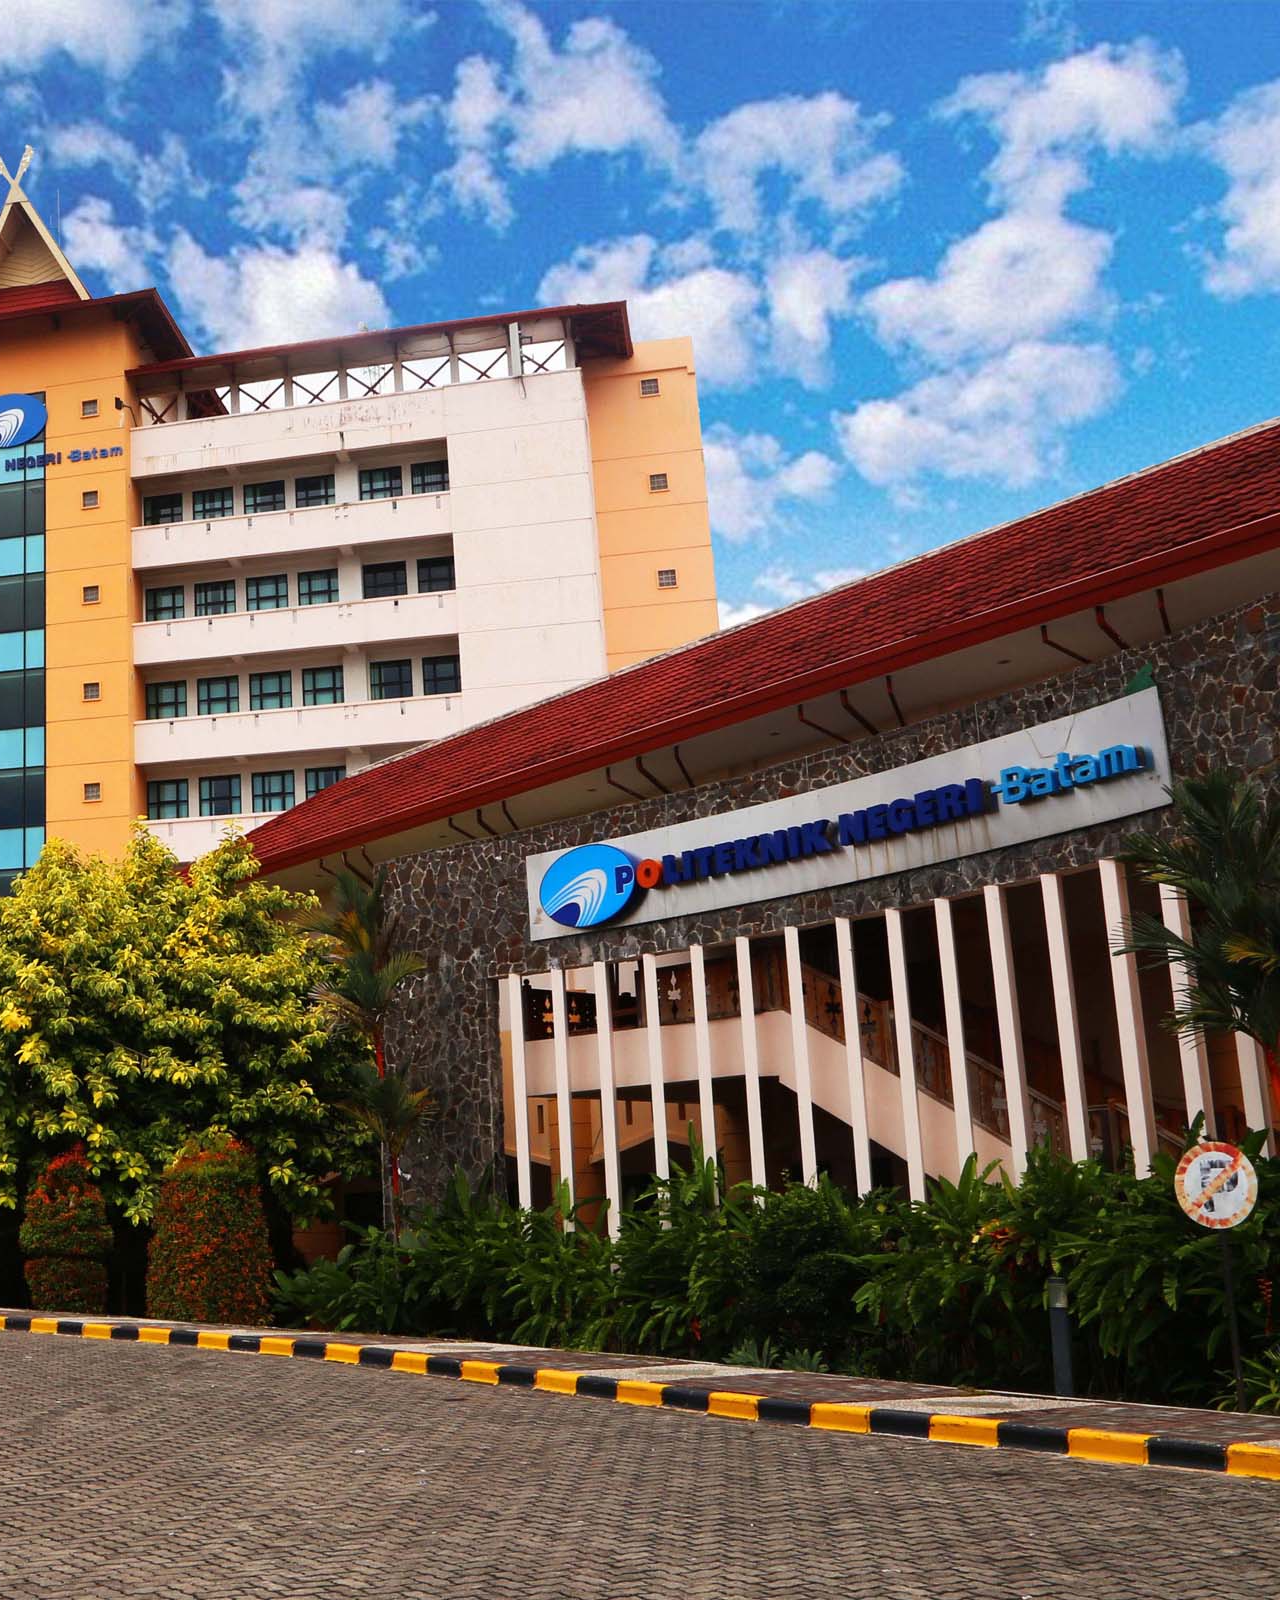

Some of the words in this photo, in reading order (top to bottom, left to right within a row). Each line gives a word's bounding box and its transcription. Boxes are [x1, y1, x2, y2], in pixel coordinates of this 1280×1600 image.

[5, 452, 62, 472] NEGERI
[614, 818, 831, 894] POLITEKNIK
[838, 778, 986, 846] NEGERI
